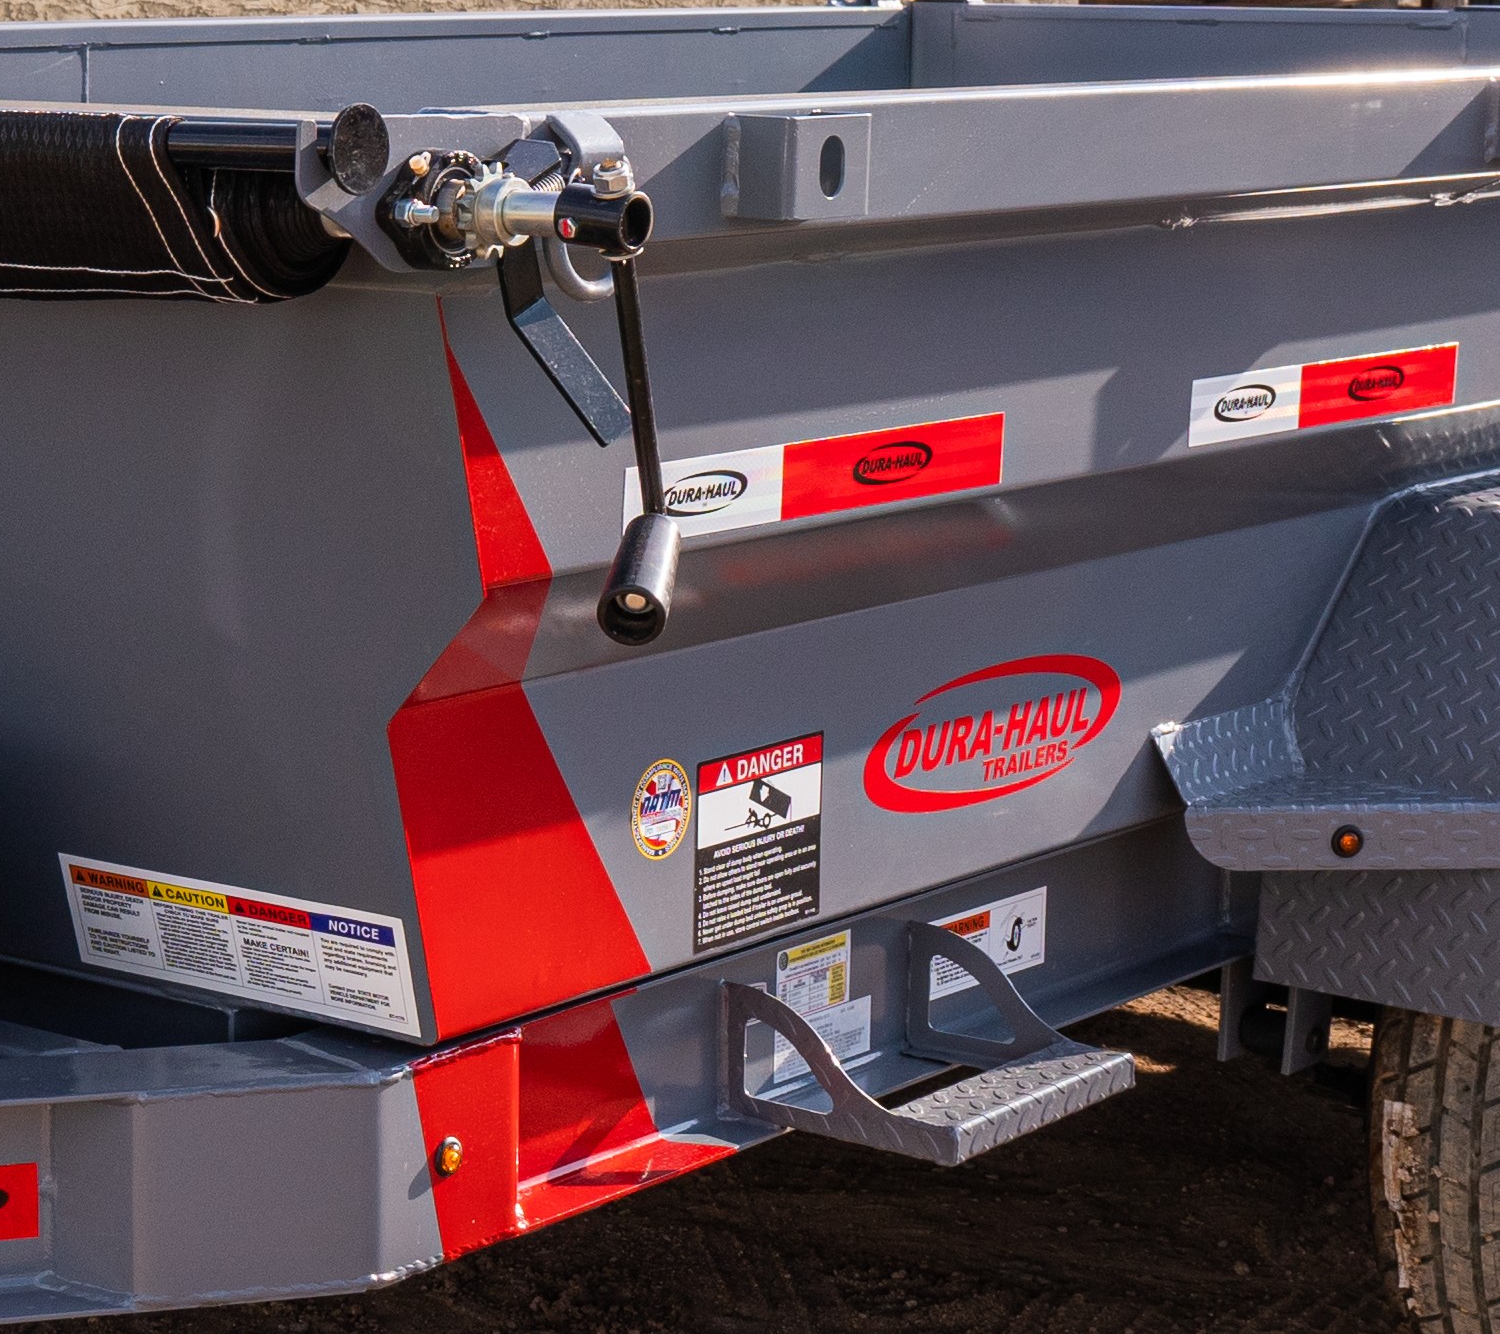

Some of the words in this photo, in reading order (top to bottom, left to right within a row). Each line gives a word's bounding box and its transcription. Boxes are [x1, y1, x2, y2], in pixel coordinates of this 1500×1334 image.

[1221, 393, 1269, 414] DURA-HAUL
[862, 451, 923, 476] DURA-HAUL
[667, 479, 737, 507] DURA-HAUL
[893, 687, 1091, 780] DURA-HAUL
[736, 743, 804, 780] DANGER
[982, 740, 1069, 782] TRAILERS
[88, 871, 145, 894] WARNING
[165, 888, 225, 909] CAUTION
[249, 904, 307, 926] DANGER
[949, 916, 985, 934] ARNING
[328, 920, 380, 940] NOTICE
[243, 937, 268, 949] MAKE
[269, 942, 309, 958] CERTAIN!
